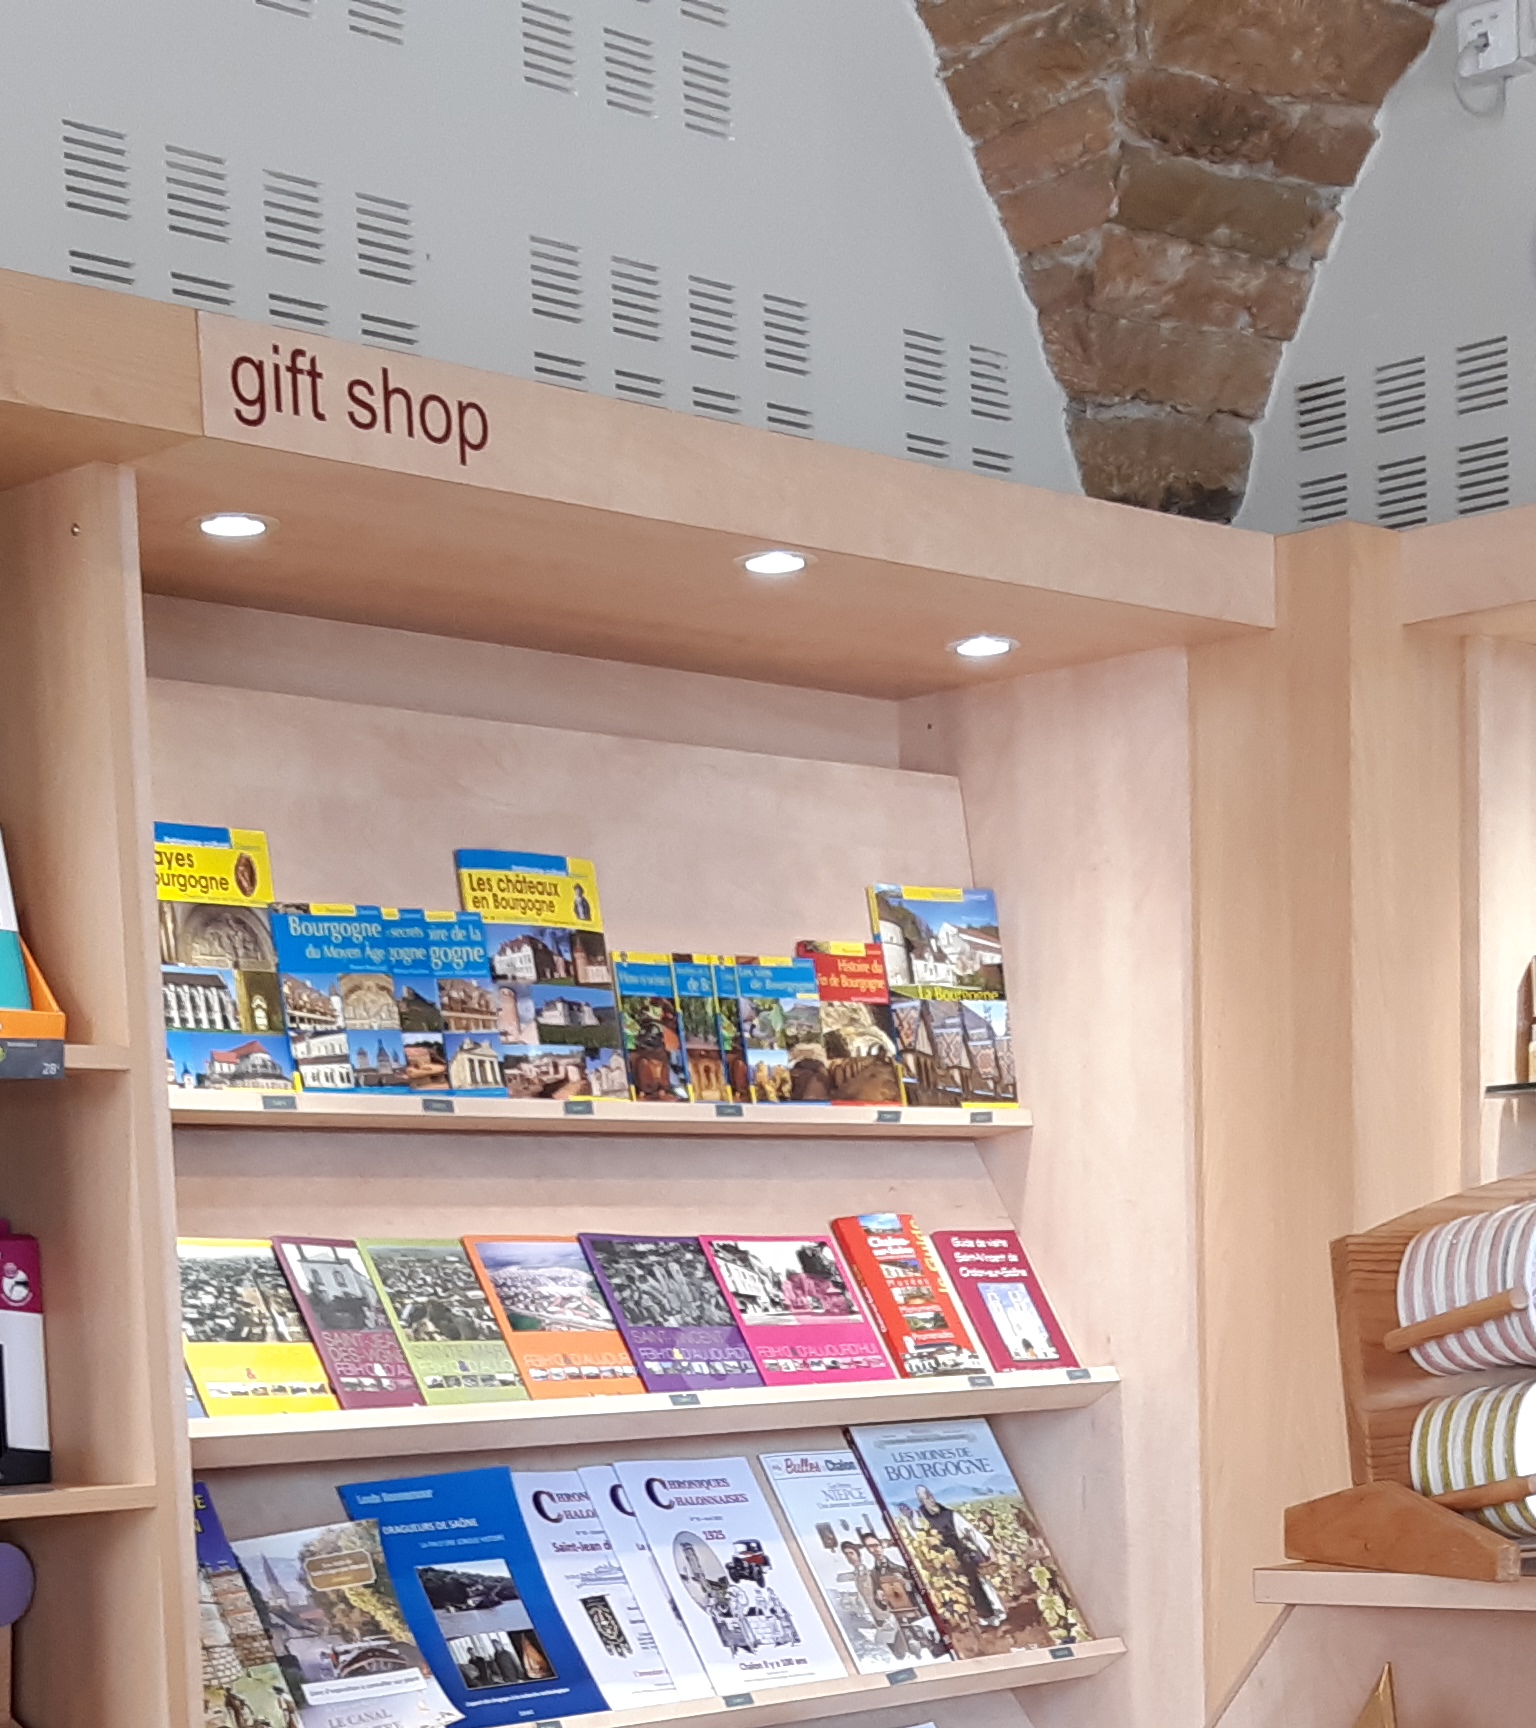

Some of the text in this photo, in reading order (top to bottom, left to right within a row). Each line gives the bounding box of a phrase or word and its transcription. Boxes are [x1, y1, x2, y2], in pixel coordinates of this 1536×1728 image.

[230, 344, 490, 466] gift shop
[467, 872, 561, 898] Les châteaux
[472, 893, 556, 916] en Bourgogne
[288, 916, 382, 944] Bourgogne
[469, 924, 482, 941] la
[305, 940, 386, 964] du Moyen Âge
[951, 1237, 976, 1248] Guide
[783, 1456, 822, 1475] Bulles
[891, 1447, 974, 1464] LES MOINES DE
[883, 1458, 994, 1482] BOURGOGNE
[349, 1708, 394, 1727] CANAL
